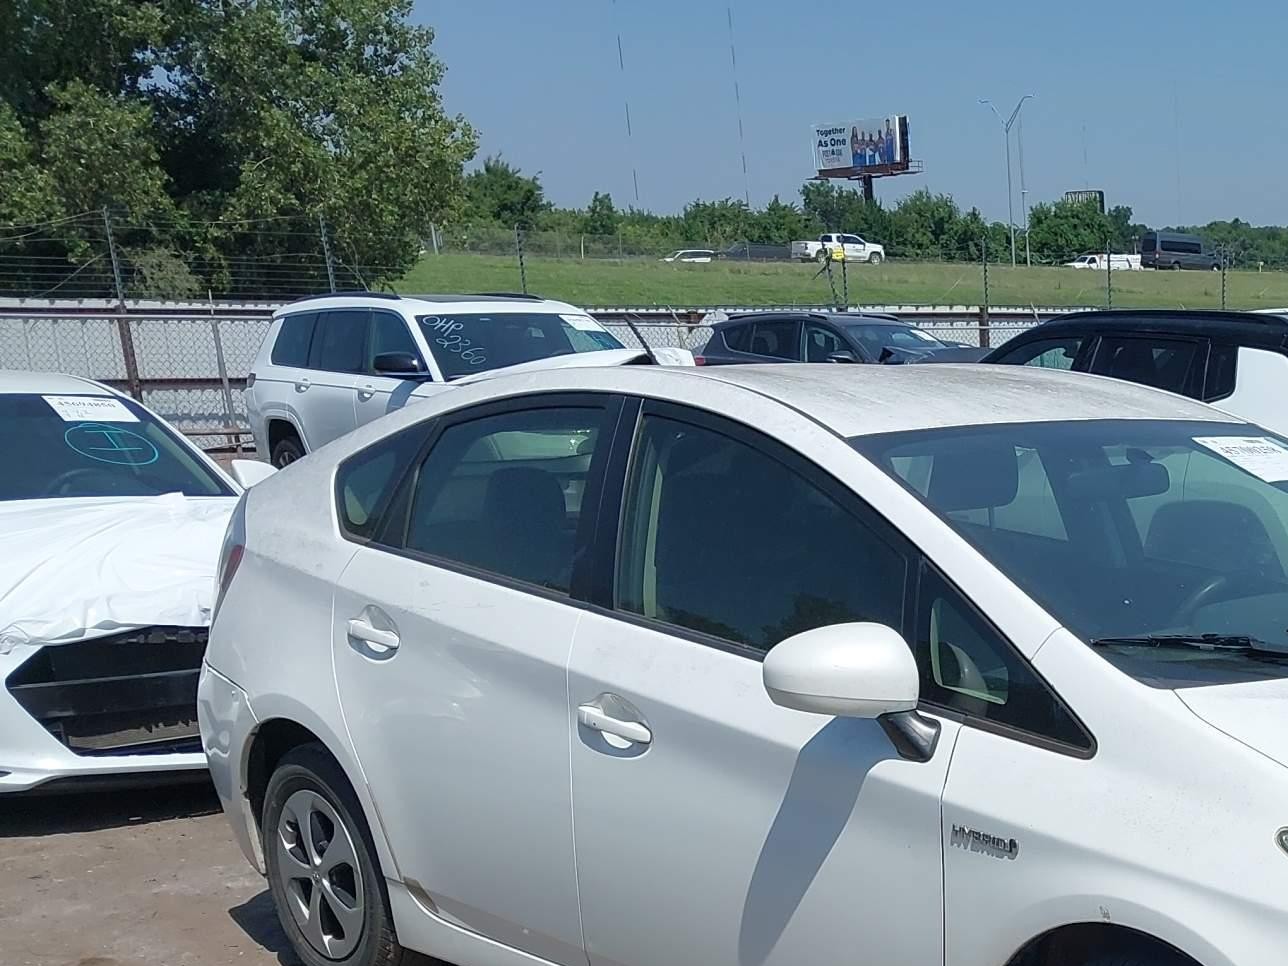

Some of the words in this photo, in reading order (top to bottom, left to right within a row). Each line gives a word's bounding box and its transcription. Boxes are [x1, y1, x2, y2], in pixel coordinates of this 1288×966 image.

[816, 127, 846, 137] Together
[818, 139, 829, 148] As
[830, 138, 846, 146] One
[422, 315, 464, 337] OHP
[436, 336, 487, 365] 2360
